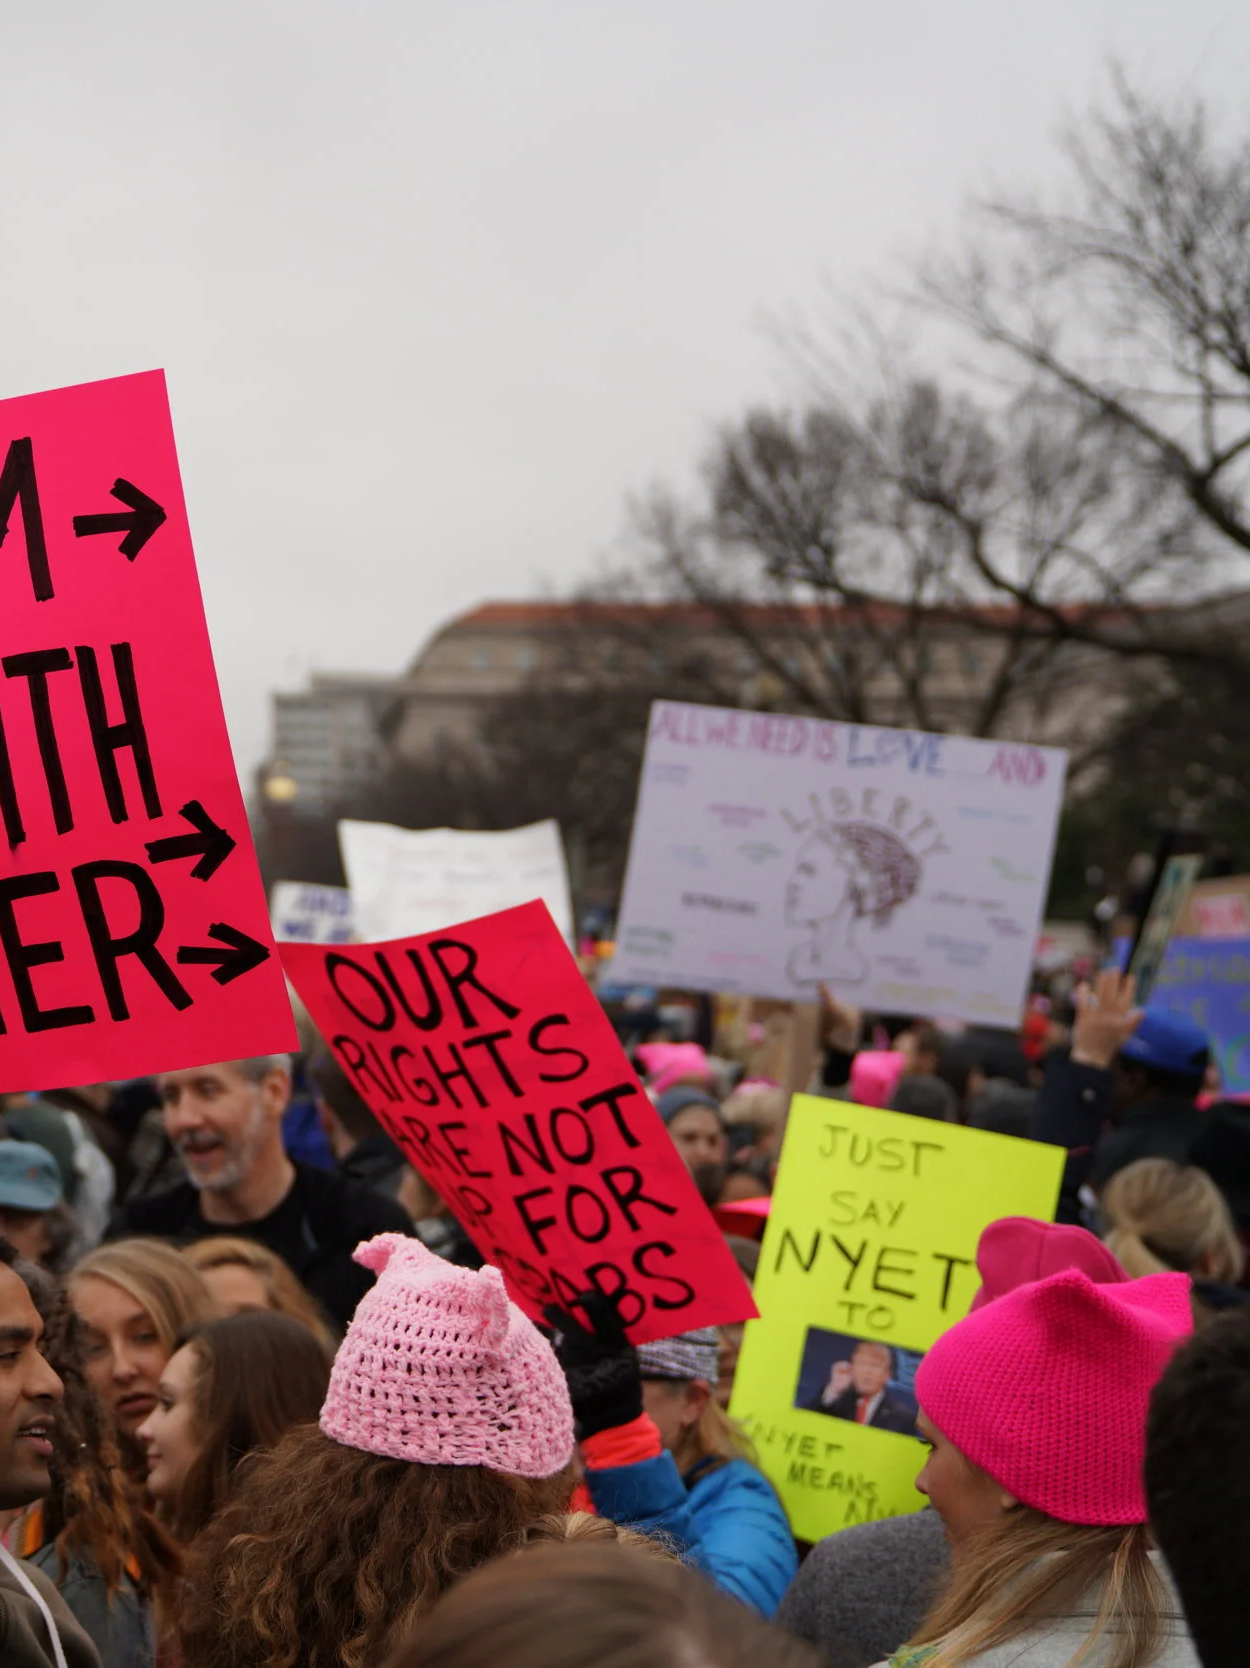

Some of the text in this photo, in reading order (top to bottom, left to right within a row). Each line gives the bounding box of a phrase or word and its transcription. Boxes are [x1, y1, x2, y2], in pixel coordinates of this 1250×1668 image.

[779, 786, 953, 858] LIBERTY
[325, 939, 521, 1032] OUR
[332, 1014, 589, 1109] RIGHTS
[380, 1083, 643, 1178] ARE NOT
[818, 1123, 946, 1177] JUST
[514, 1166, 678, 1256] FOR
[829, 1190, 905, 1229] SAY
[774, 1227, 972, 1311] NYET
[837, 1300, 896, 1330] TO
[786, 1460, 879, 1500] MEANS
